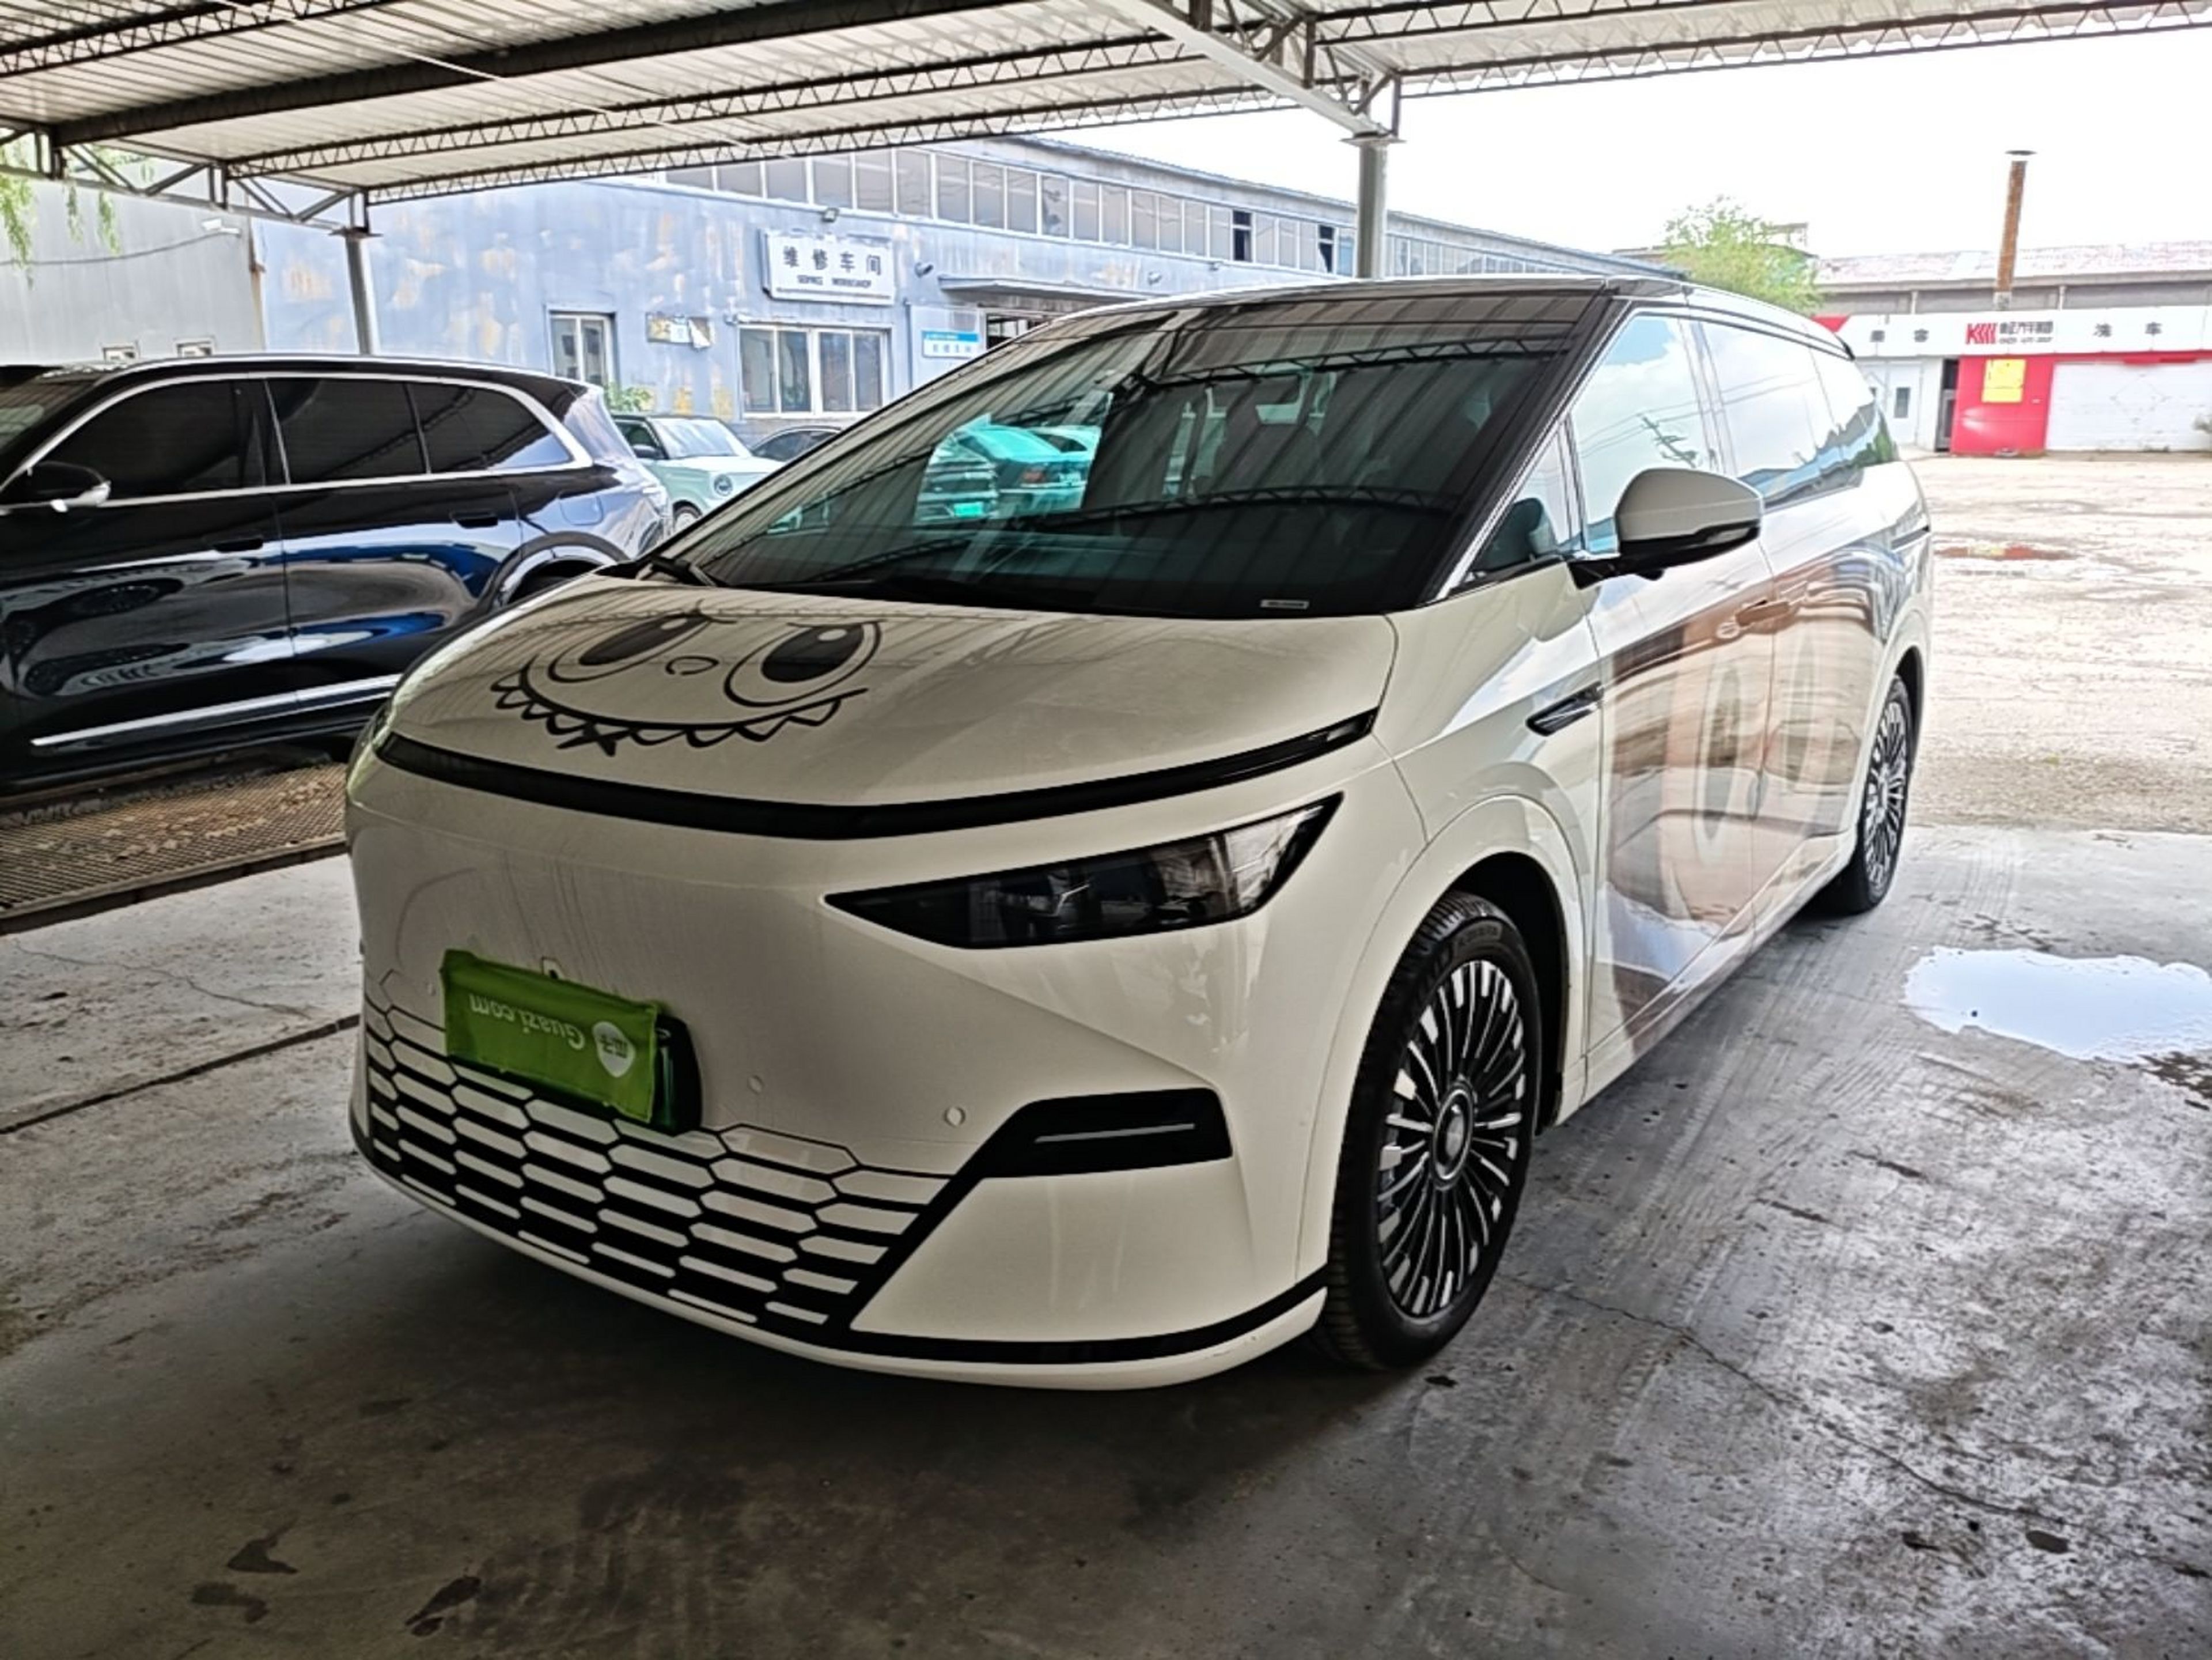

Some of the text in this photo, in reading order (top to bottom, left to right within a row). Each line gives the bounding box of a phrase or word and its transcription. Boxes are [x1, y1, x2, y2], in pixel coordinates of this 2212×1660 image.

[782, 245, 882, 276] 维修车间
[468, 992, 586, 1050] Guazi.com
